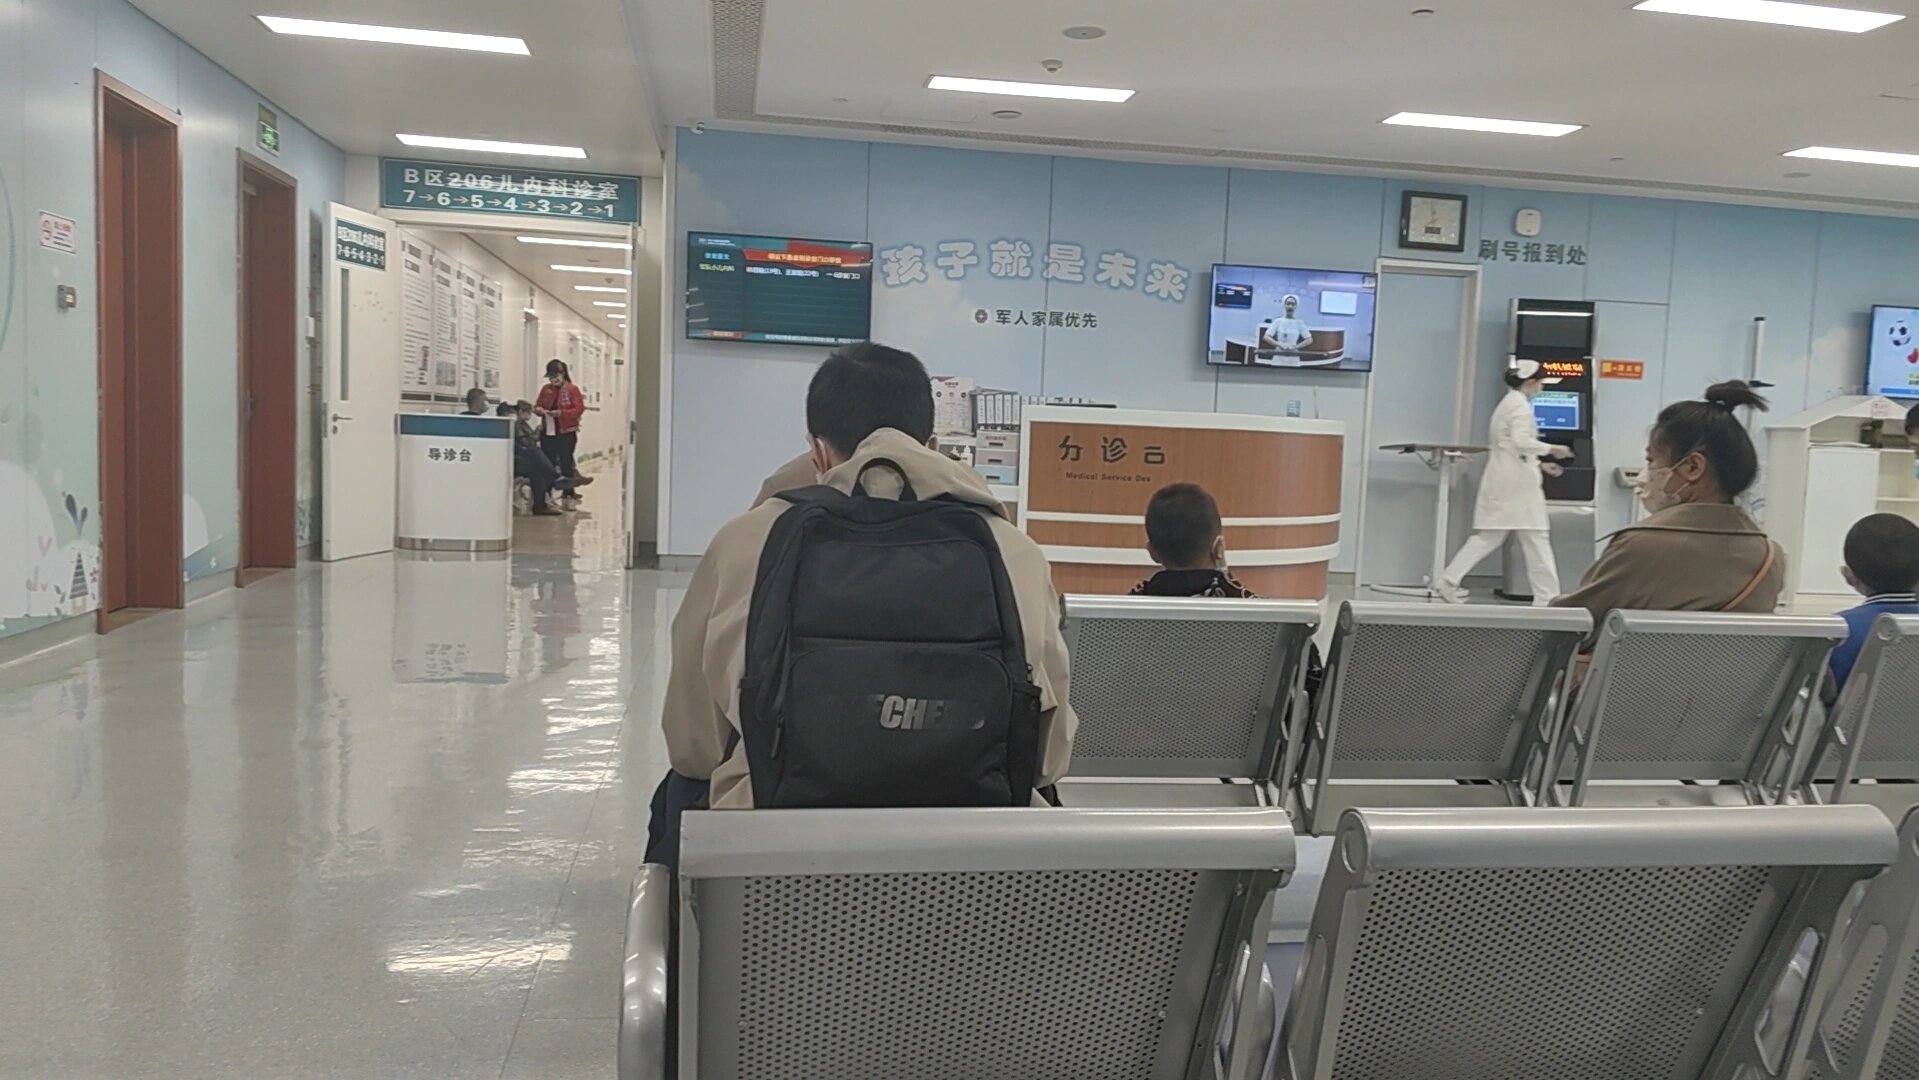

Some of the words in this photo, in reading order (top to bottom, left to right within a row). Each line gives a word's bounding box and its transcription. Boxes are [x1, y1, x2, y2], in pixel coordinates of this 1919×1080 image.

[1477, 239, 1587, 266] 刷号报到处
[881, 240, 1189, 301] 孩子就是未来
[995, 309, 1098, 328] 军人家属优先
[427, 447, 472, 462] 导诊台
[1065, 472, 1098, 481] Medical
[1101, 473, 1132, 482] Service
